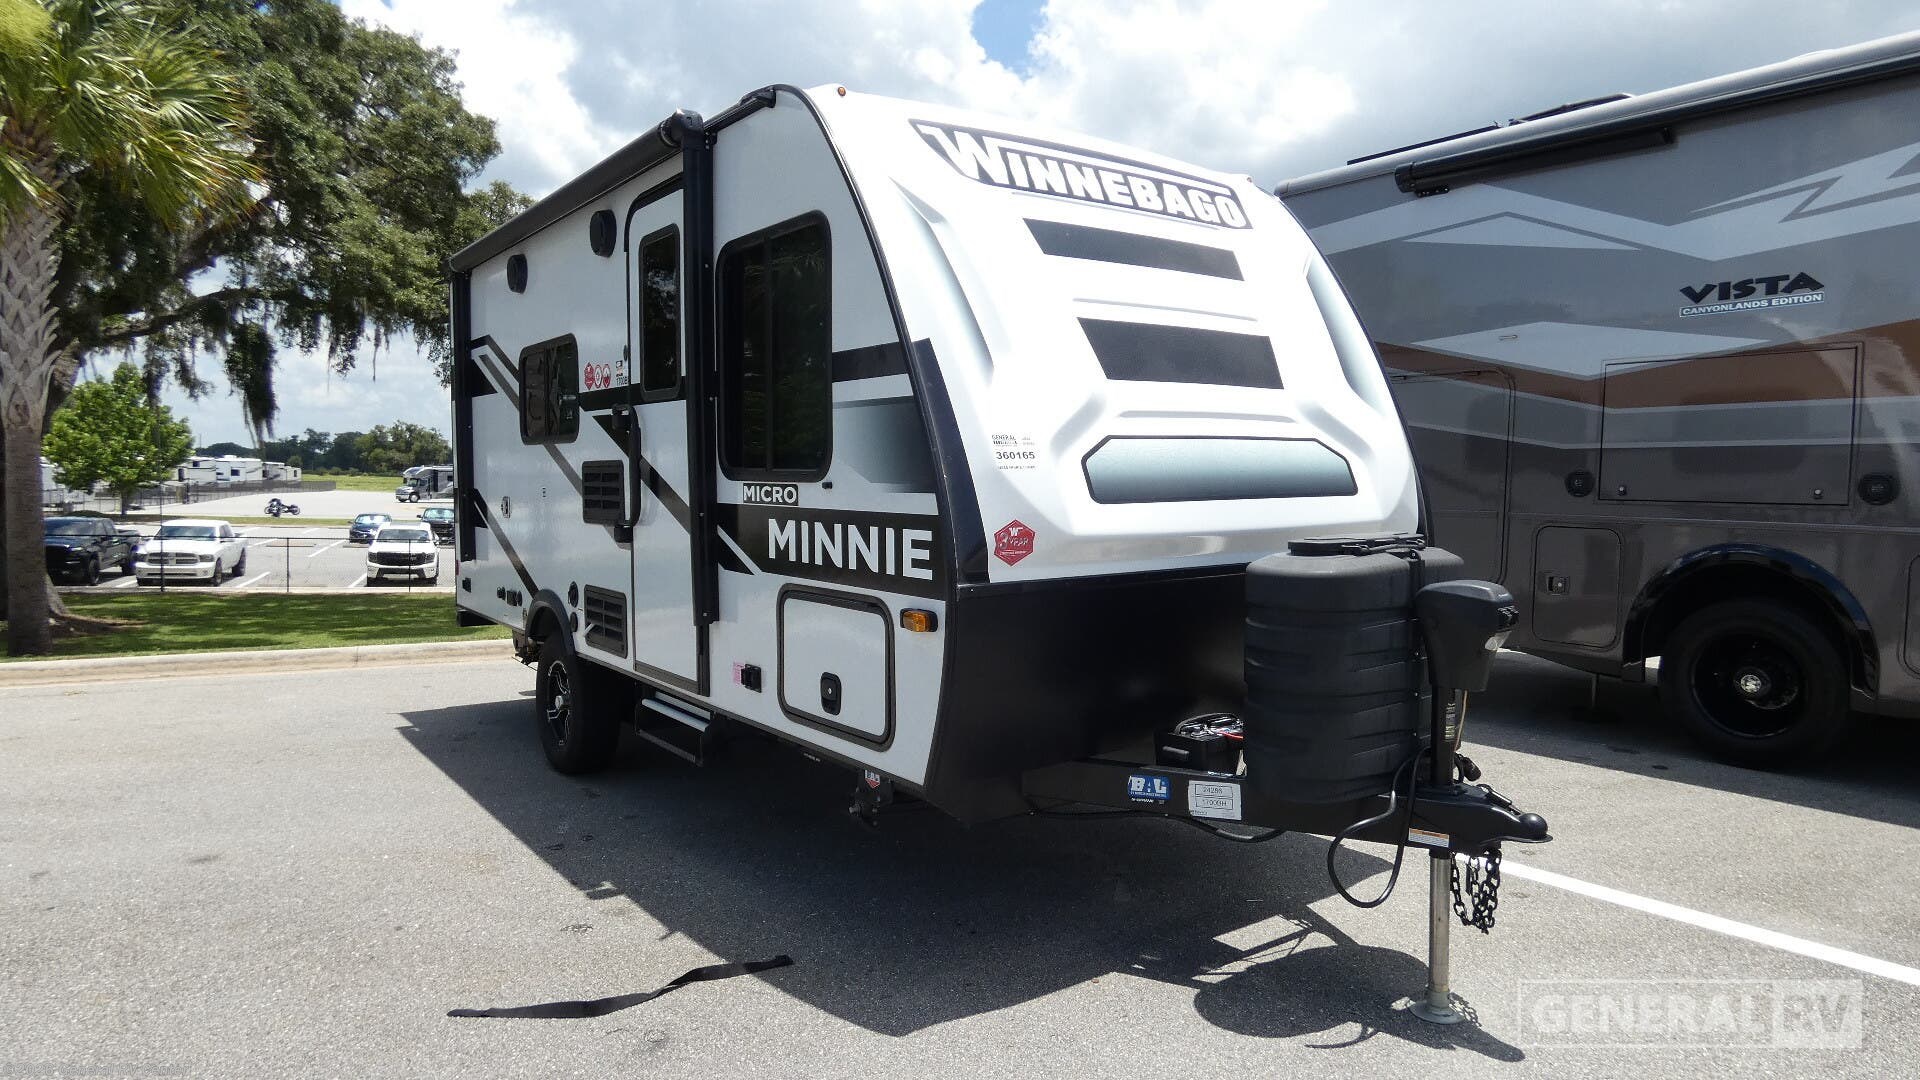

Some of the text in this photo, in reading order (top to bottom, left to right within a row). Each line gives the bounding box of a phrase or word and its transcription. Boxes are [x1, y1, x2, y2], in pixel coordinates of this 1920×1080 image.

[915, 123, 1249, 228] WINNEBAGO
[1679, 271, 1825, 304] VISTA
[1682, 294, 1823, 316] CANYONLANDS EDITION
[995, 451, 1036, 460] 360165
[743, 486, 798, 503] MICRO
[768, 518, 933, 580] MINNIE
